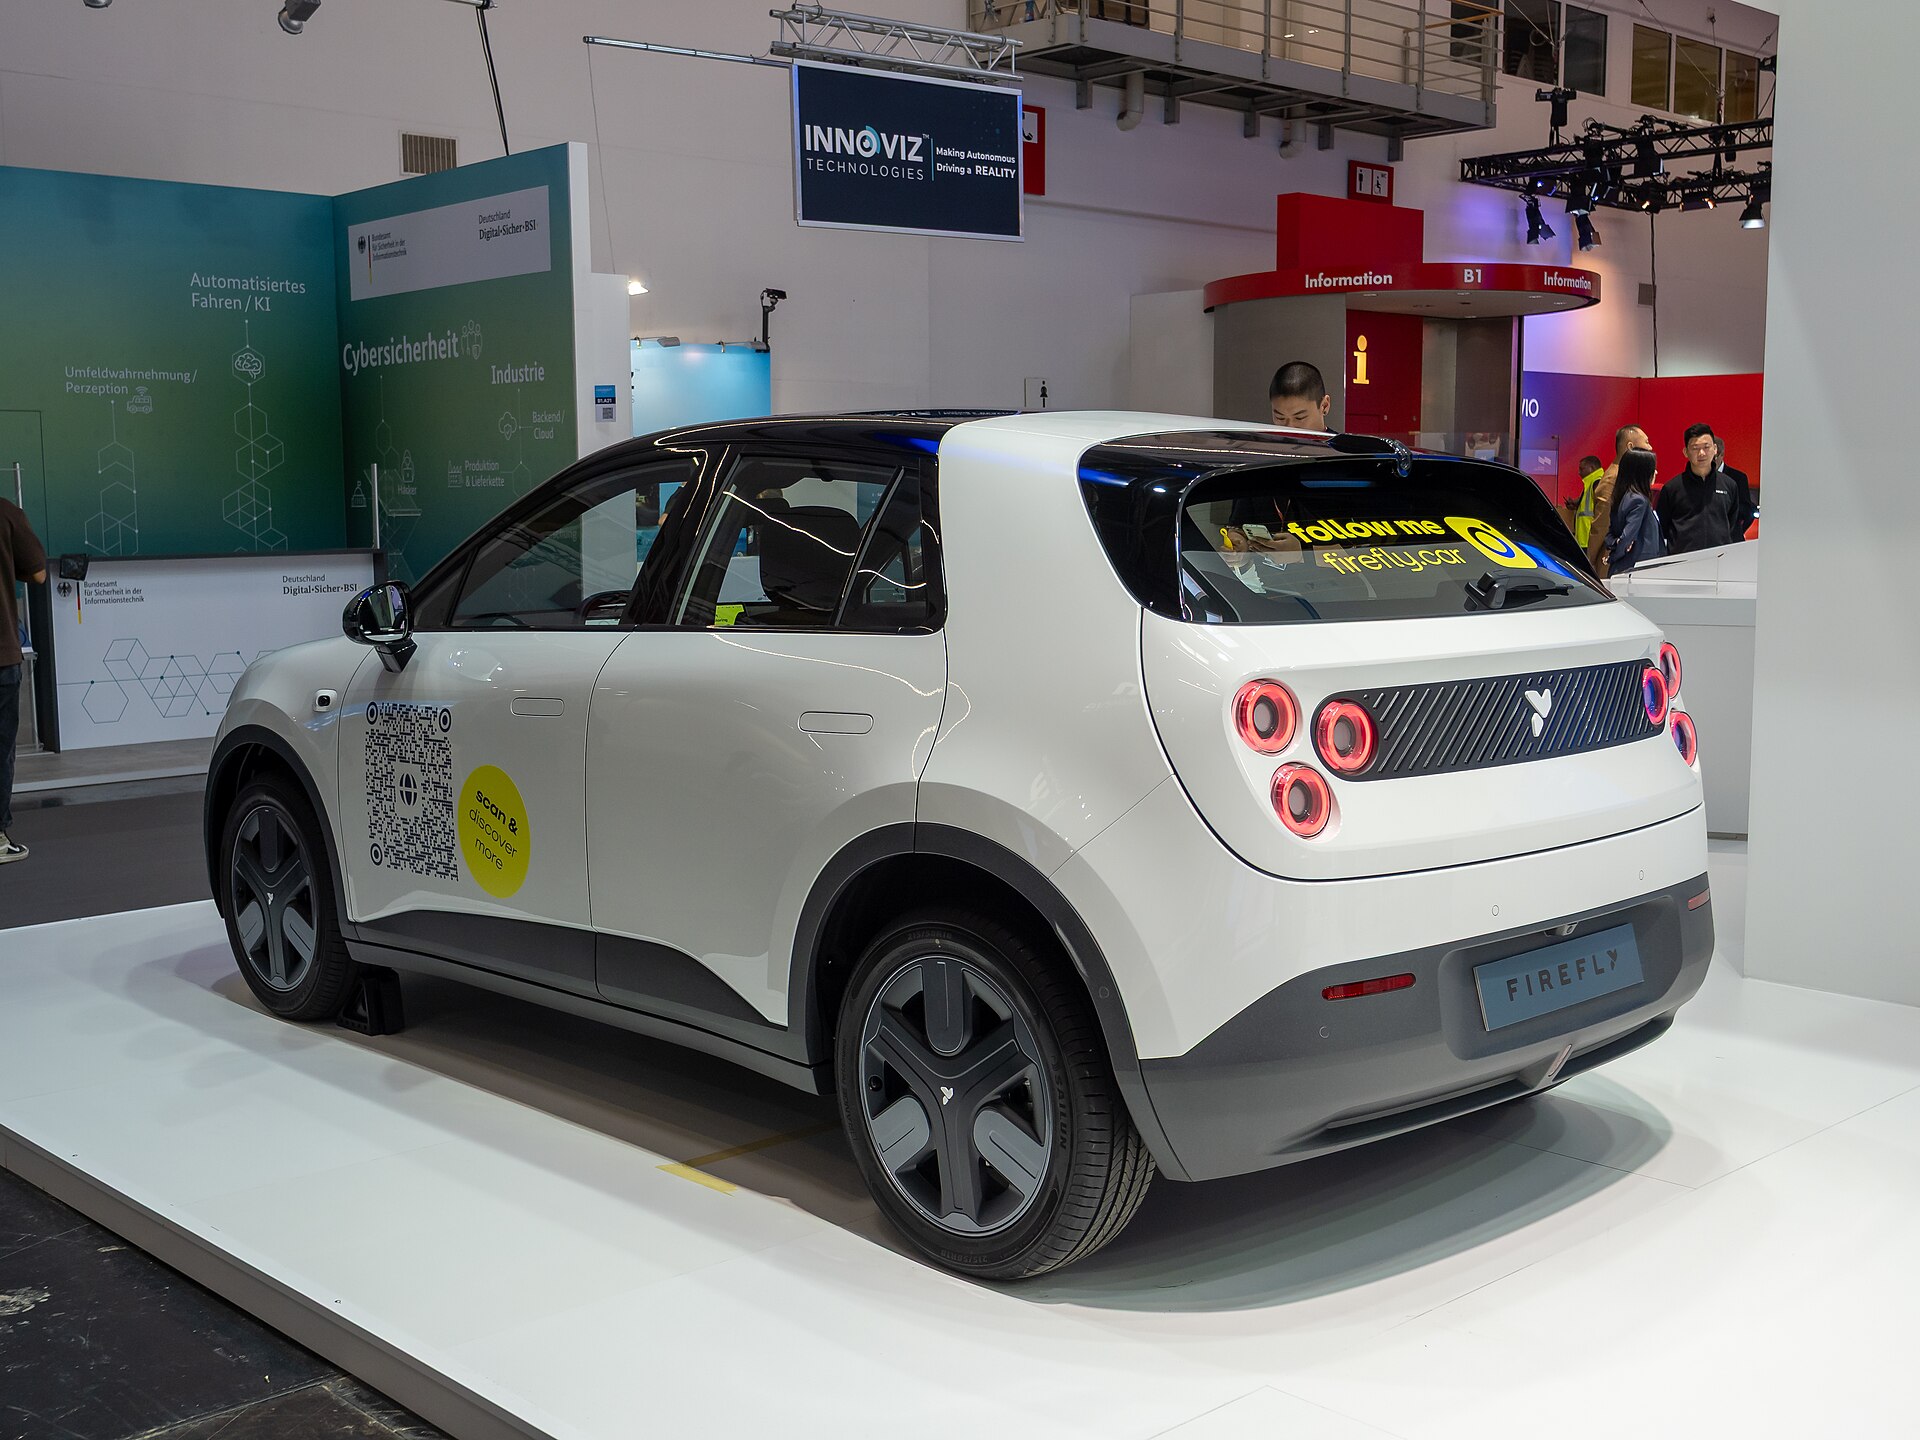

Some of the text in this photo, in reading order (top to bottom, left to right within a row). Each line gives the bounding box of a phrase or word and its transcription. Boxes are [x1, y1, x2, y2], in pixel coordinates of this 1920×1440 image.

[805, 124, 924, 163] INNOVIZ
[936, 147, 1016, 164] Making Autonomous
[806, 157, 924, 181] TECHNOLOGIES
[936, 163, 1016, 179] Driving a REALITY
[478, 209, 511, 224] Deutschland
[190, 272, 306, 295] Automatisiertes
[1304, 271, 1393, 289] Information
[1463, 269, 1482, 284] B1
[1543, 271, 1592, 290] Information
[191, 293, 242, 311] Fahren
[254, 296, 271, 312] KI
[342, 330, 459, 376] Cybersicherheit
[491, 361, 545, 385] Industrie
[65, 382, 129, 397] Perzeption
[533, 427, 554, 440] Cloud
[465, 460, 499, 471] Produktion
[466, 475, 505, 488] & Lieferkette
[1286, 518, 1446, 543] follow me
[1322, 547, 1467, 575] firefly.car
[84, 581, 118, 589] Bundesamt
[282, 574, 326, 584] Deutschland
[84, 587, 142, 597] für Sicherheit in der
[84, 596, 145, 605] Informationstechnik
[475, 790, 518, 836] scan &
[469, 808, 518, 858] discover
[475, 837, 504, 871] more
[1506, 948, 1618, 1002] FIREFLY
[1054, 1074, 1068, 1150] SAILUN
